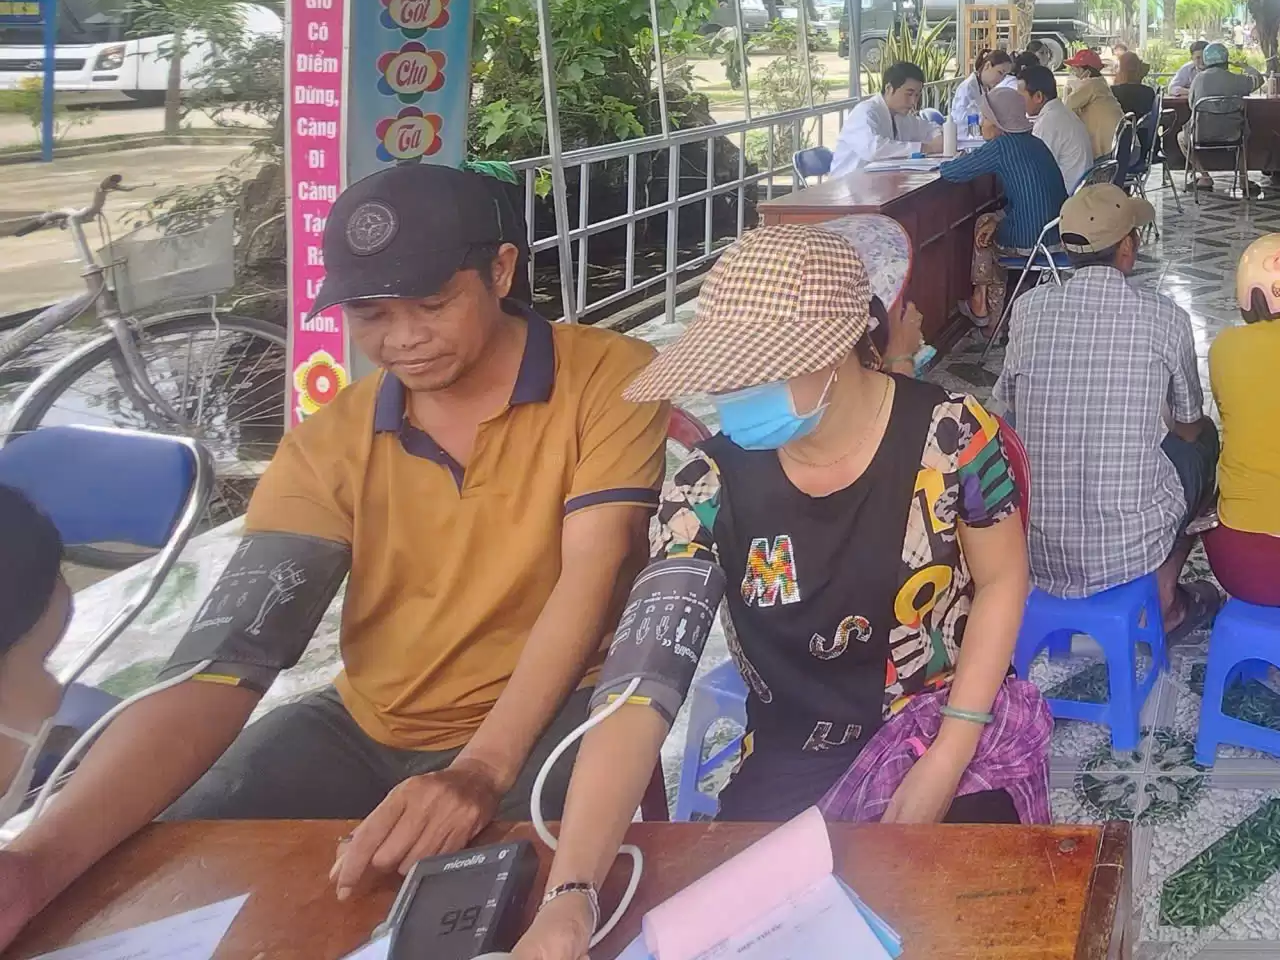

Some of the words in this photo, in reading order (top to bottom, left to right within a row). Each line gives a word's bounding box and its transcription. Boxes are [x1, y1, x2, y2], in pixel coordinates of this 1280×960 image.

[307, 21, 329, 41] Có
[396, 60, 428, 86] Cho
[296, 116, 337, 139] Càng
[397, 124, 422, 153] Ta
[298, 181, 337, 203] Càng
[443, 853, 486, 872] microlife
